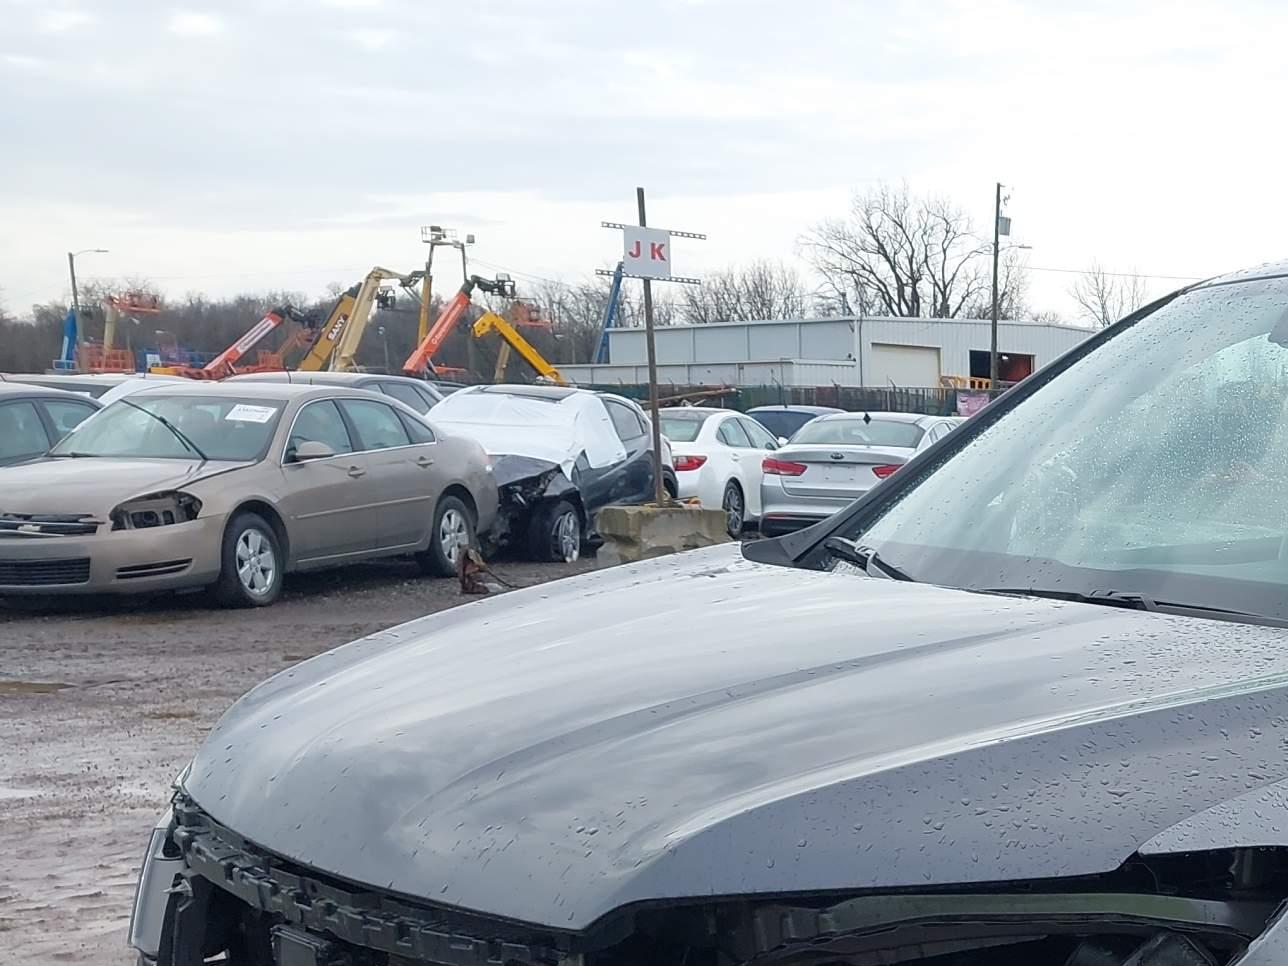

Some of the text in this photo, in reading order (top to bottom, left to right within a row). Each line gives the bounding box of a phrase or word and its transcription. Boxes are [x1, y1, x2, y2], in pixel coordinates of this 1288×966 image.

[628, 240, 666, 261] J K
[327, 315, 345, 341] SANY
